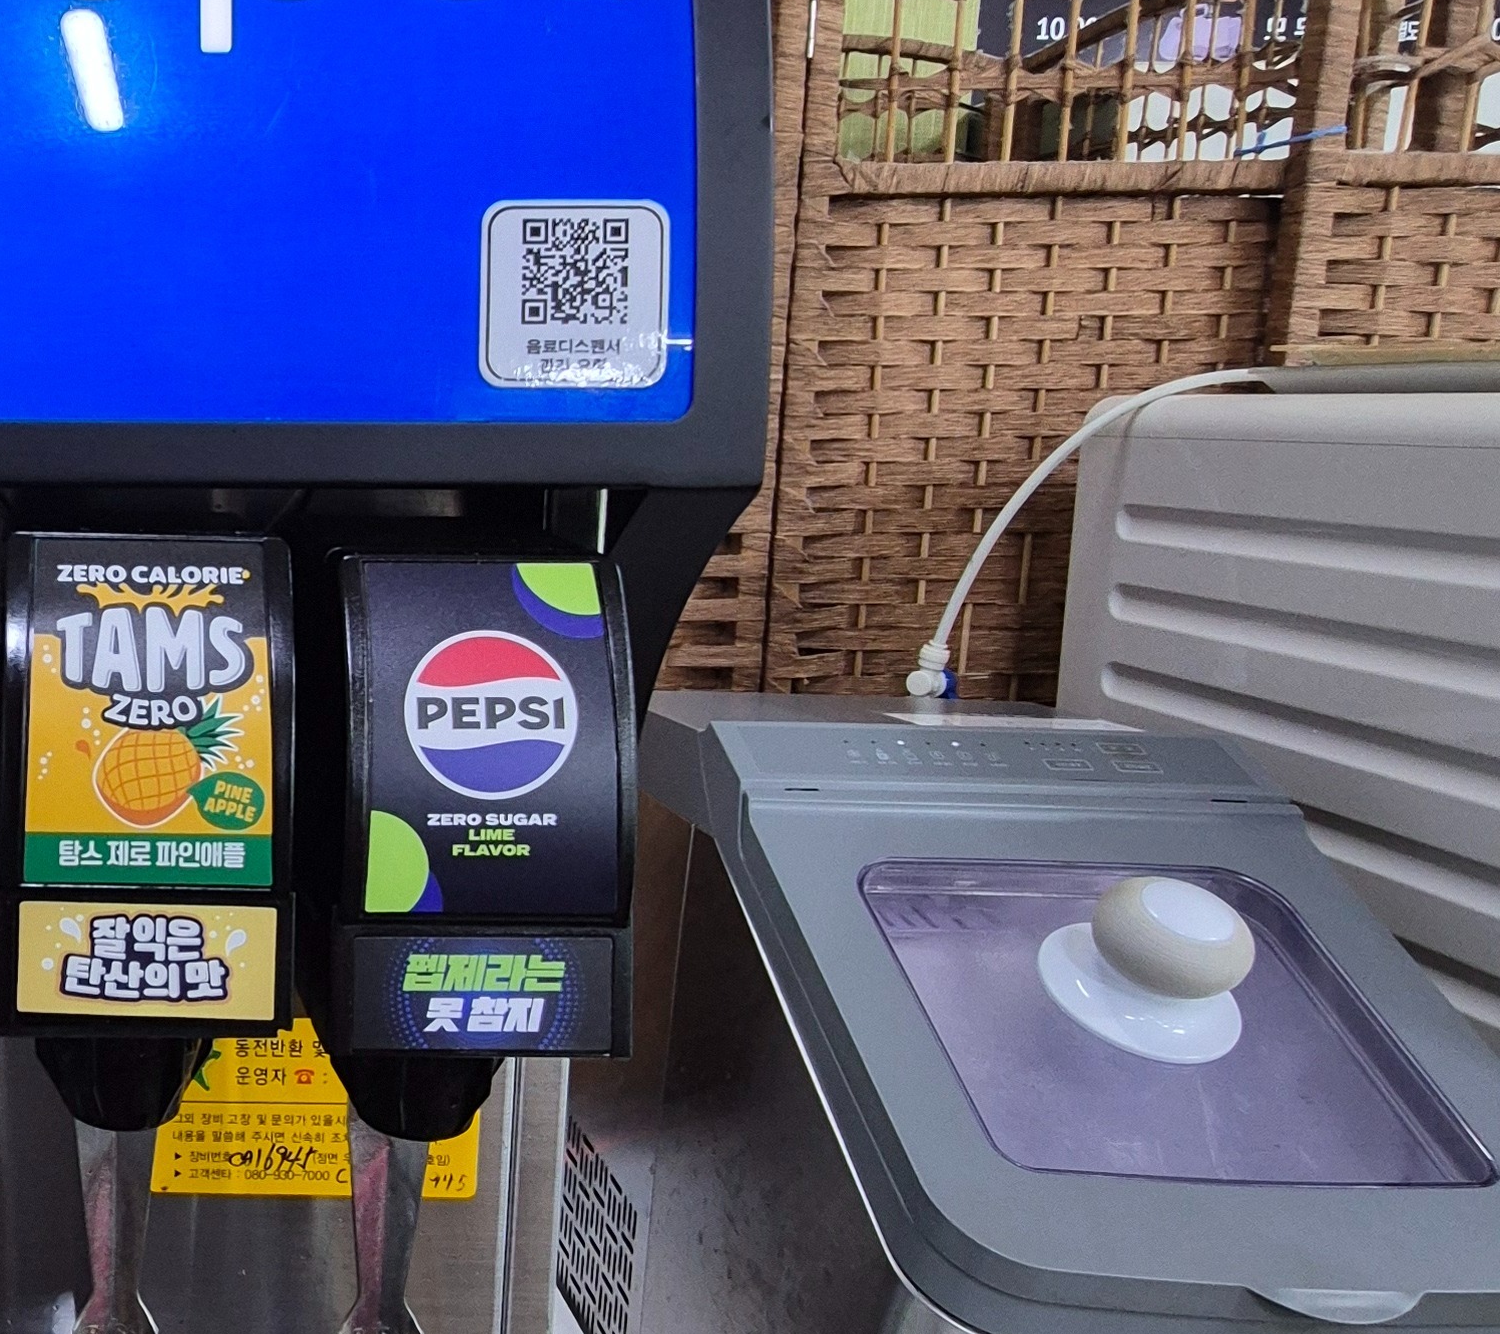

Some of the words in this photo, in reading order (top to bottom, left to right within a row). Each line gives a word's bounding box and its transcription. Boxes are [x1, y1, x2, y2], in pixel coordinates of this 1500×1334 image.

[56, 565, 127, 584] ZERO
[131, 566, 245, 585] CALORIE
[56, 606, 245, 693] TAMS
[104, 694, 198, 726] ZERO
[417, 696, 566, 731] PEPSI
[214, 779, 254, 805] PINE
[203, 797, 257, 823] APPLE
[427, 814, 483, 826] ZERO
[485, 814, 557, 827] SUGAR
[468, 829, 515, 841] LIME
[58, 840, 103, 867] 탐스
[109, 840, 151, 867] 제로
[155, 840, 246, 868] 파인애플
[452, 844, 531, 856] FLAVOR
[423, 998, 465, 1033] 못
[467, 998, 545, 1033] 참지
[235, 1039, 303, 1058] 동전반환
[235, 1067, 287, 1086] 운영자
